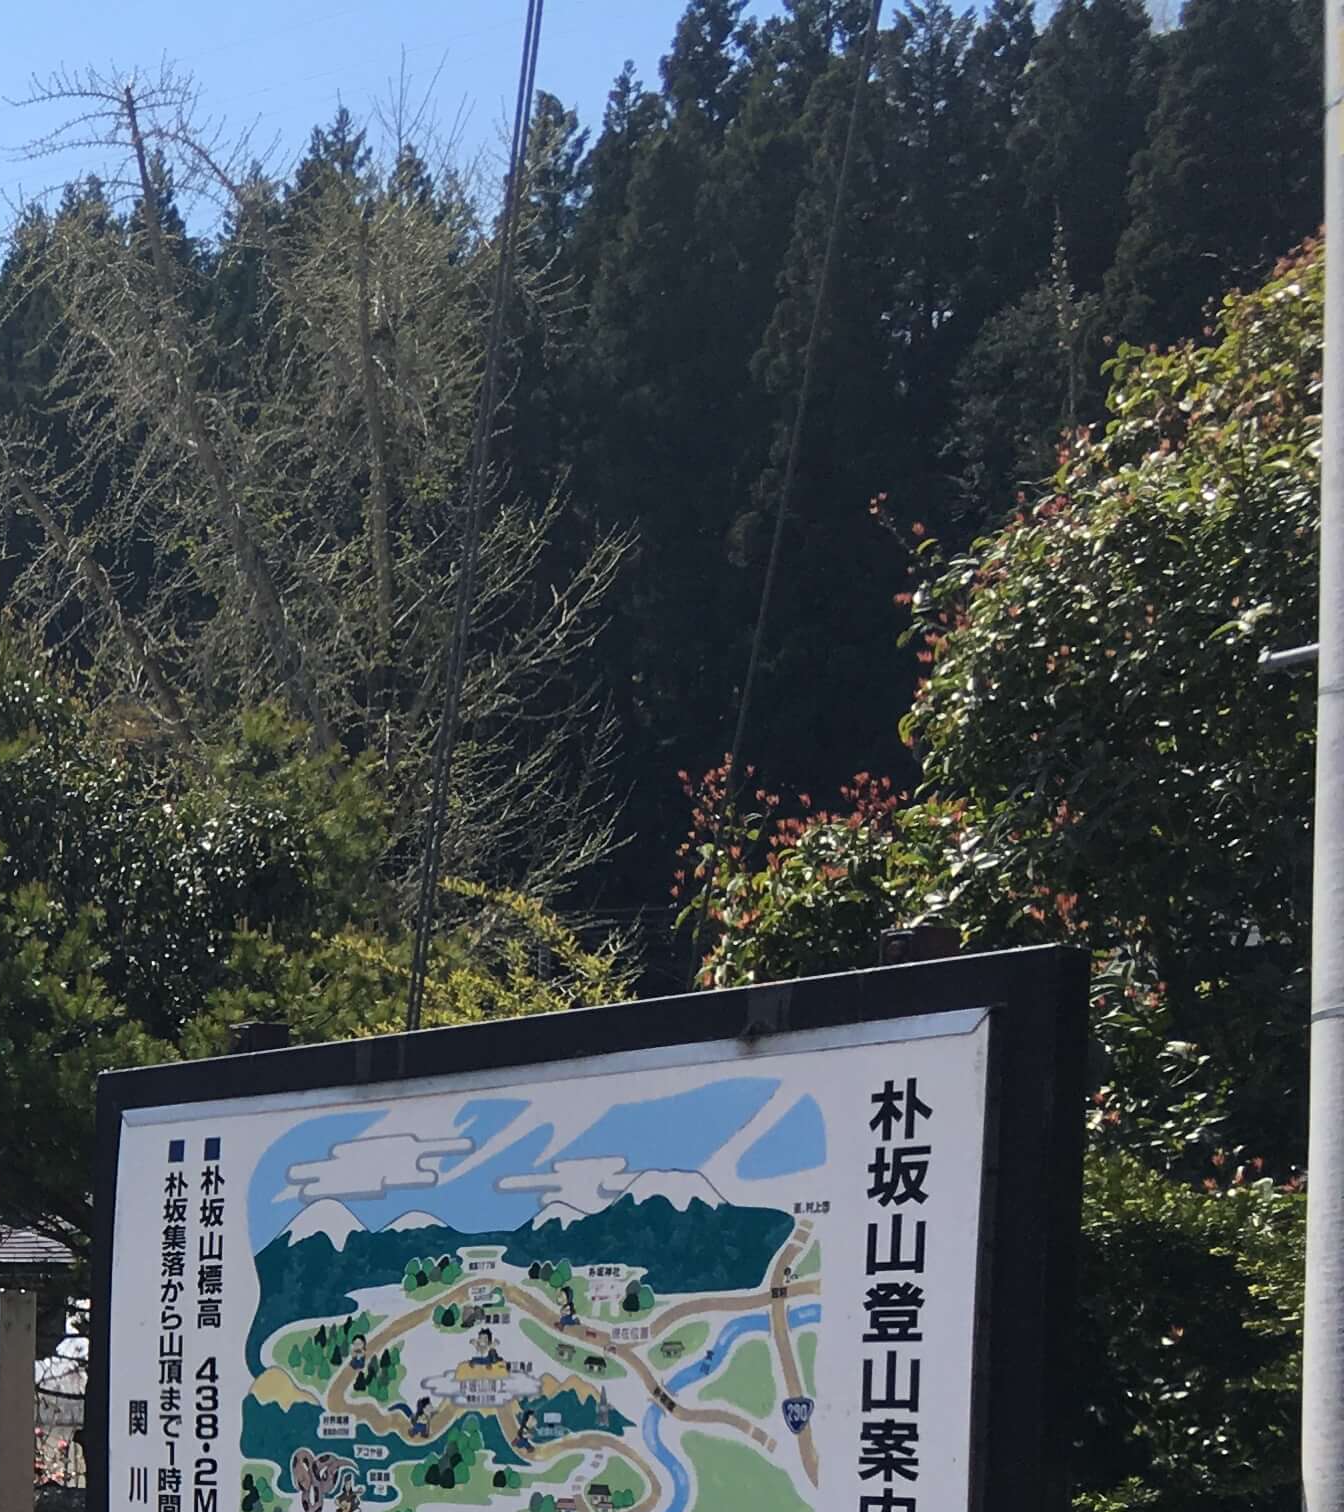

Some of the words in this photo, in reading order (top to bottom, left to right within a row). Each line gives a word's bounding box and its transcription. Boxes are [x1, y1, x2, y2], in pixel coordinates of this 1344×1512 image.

[197, 1165, 225, 1329] 朴坂山標高
